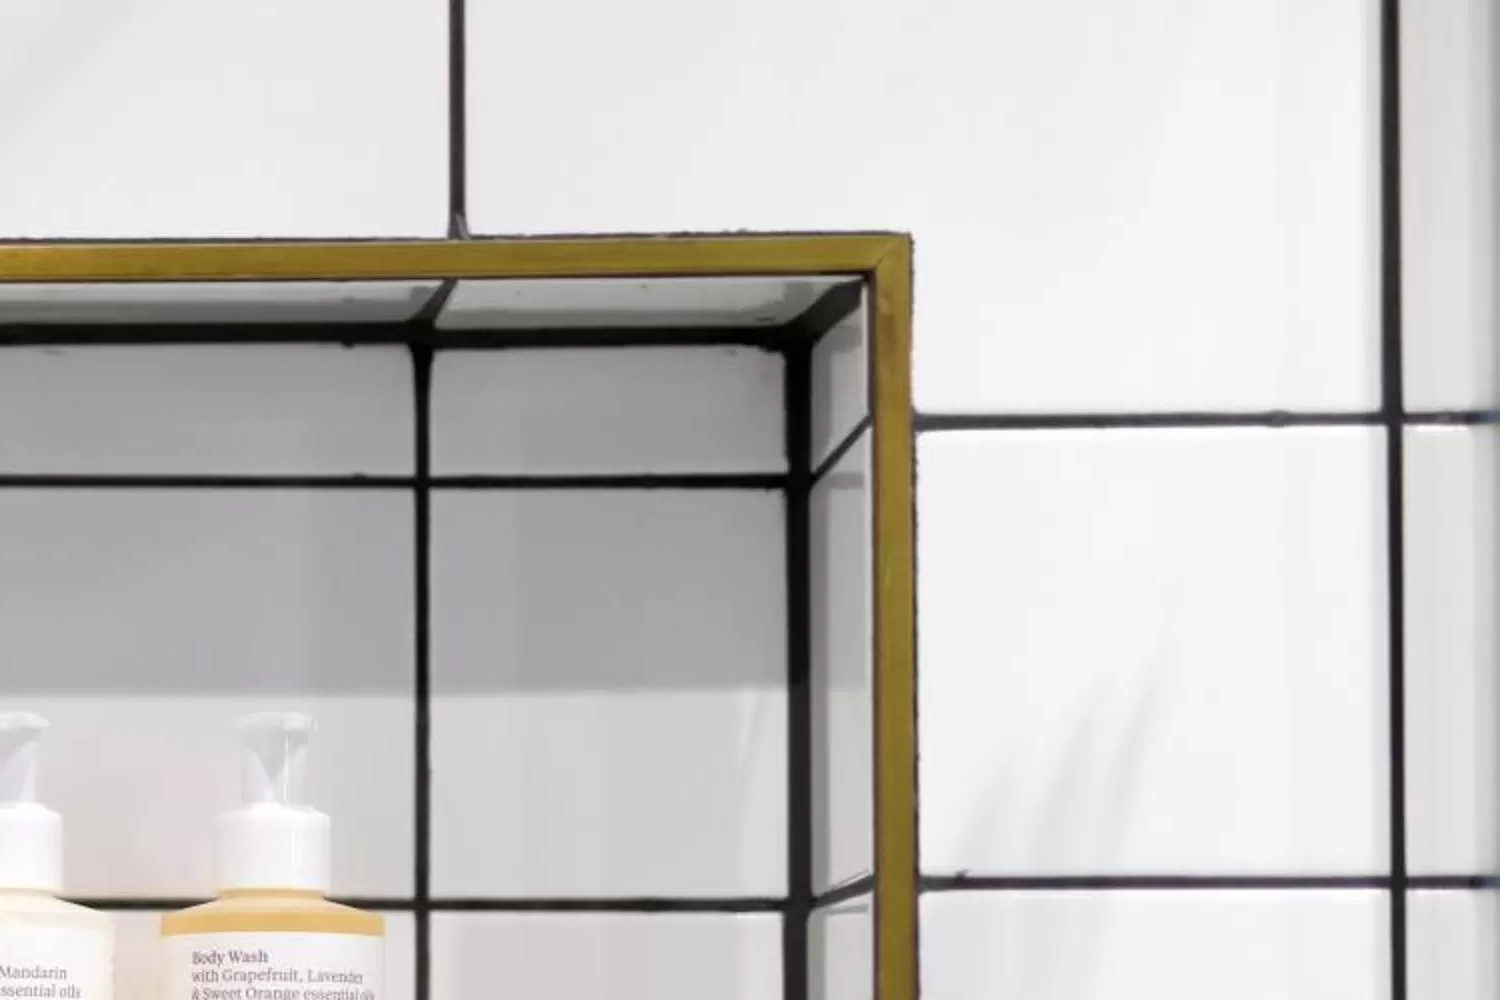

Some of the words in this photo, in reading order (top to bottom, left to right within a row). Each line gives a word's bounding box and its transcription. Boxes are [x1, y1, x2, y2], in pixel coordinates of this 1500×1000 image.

[192, 951, 226, 966] Body
[228, 950, 269, 965] Wash
[191, 969, 219, 983] with
[221, 968, 304, 984] Grapefruit,
[307, 969, 364, 985] Lavender
[59, 984, 82, 999] oils
[191, 988, 200, 1000] &
[203, 987, 242, 1000] Sweet
